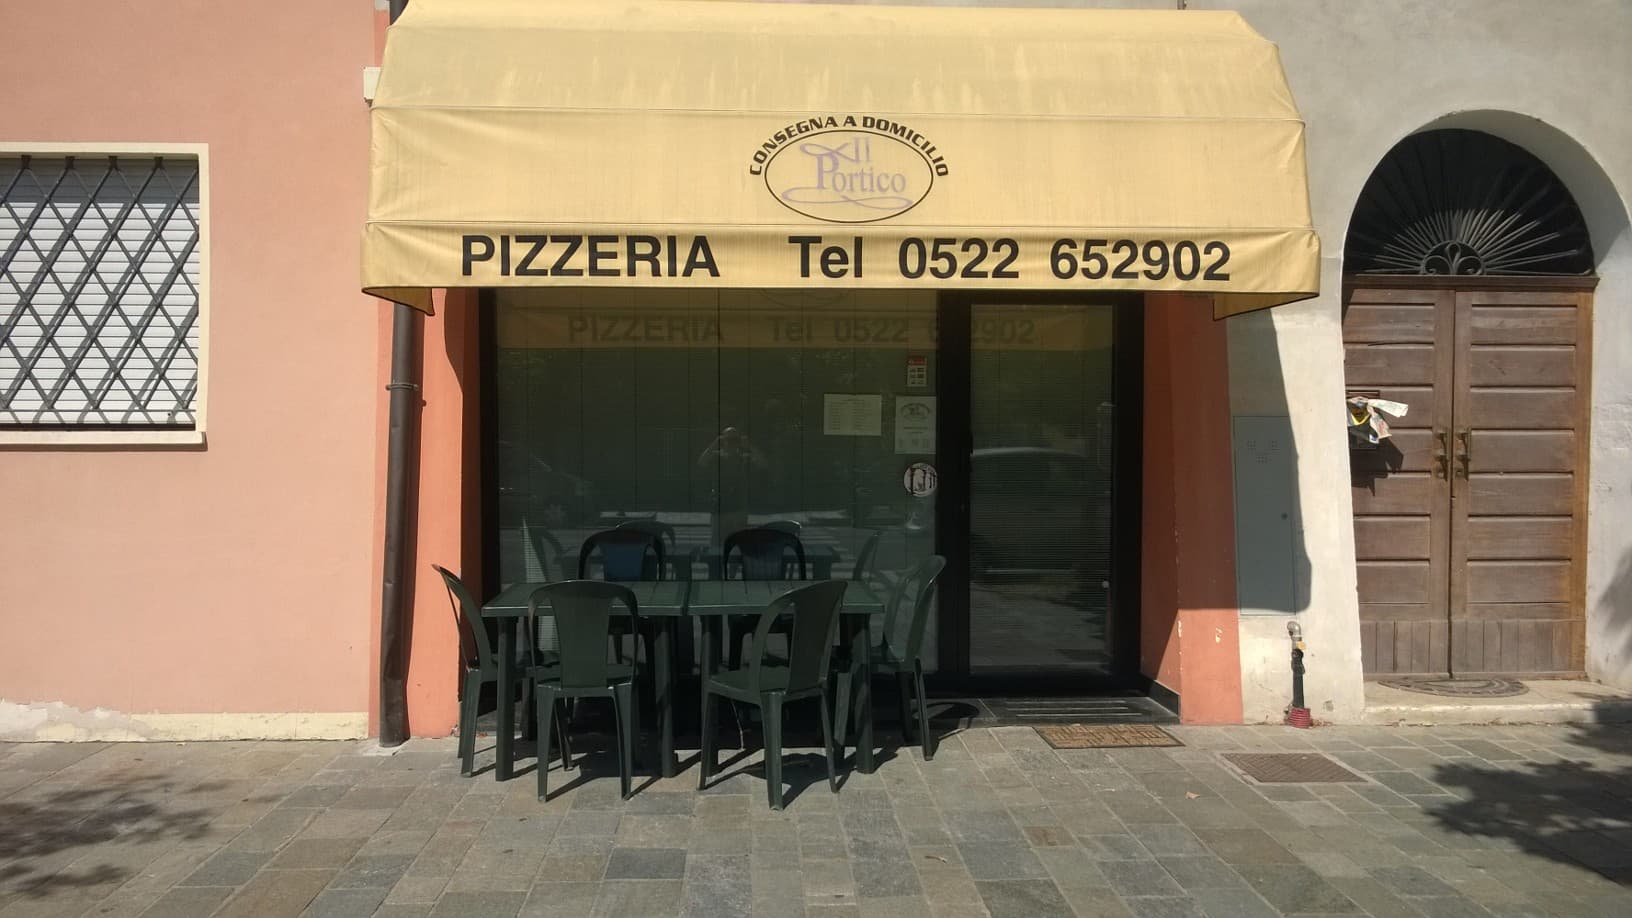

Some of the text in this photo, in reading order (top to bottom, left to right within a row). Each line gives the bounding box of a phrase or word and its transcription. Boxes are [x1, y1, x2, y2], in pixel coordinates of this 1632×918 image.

[750, 115, 949, 177] CONSEGNA A DOMICILIO
[816, 152, 906, 193] Portico
[462, 235, 1231, 281] PIZZERIA Tel 0522 652902
[568, 314, 724, 343] PIZZERIA
[771, 315, 812, 343] Tel
[834, 316, 909, 344] 0522
